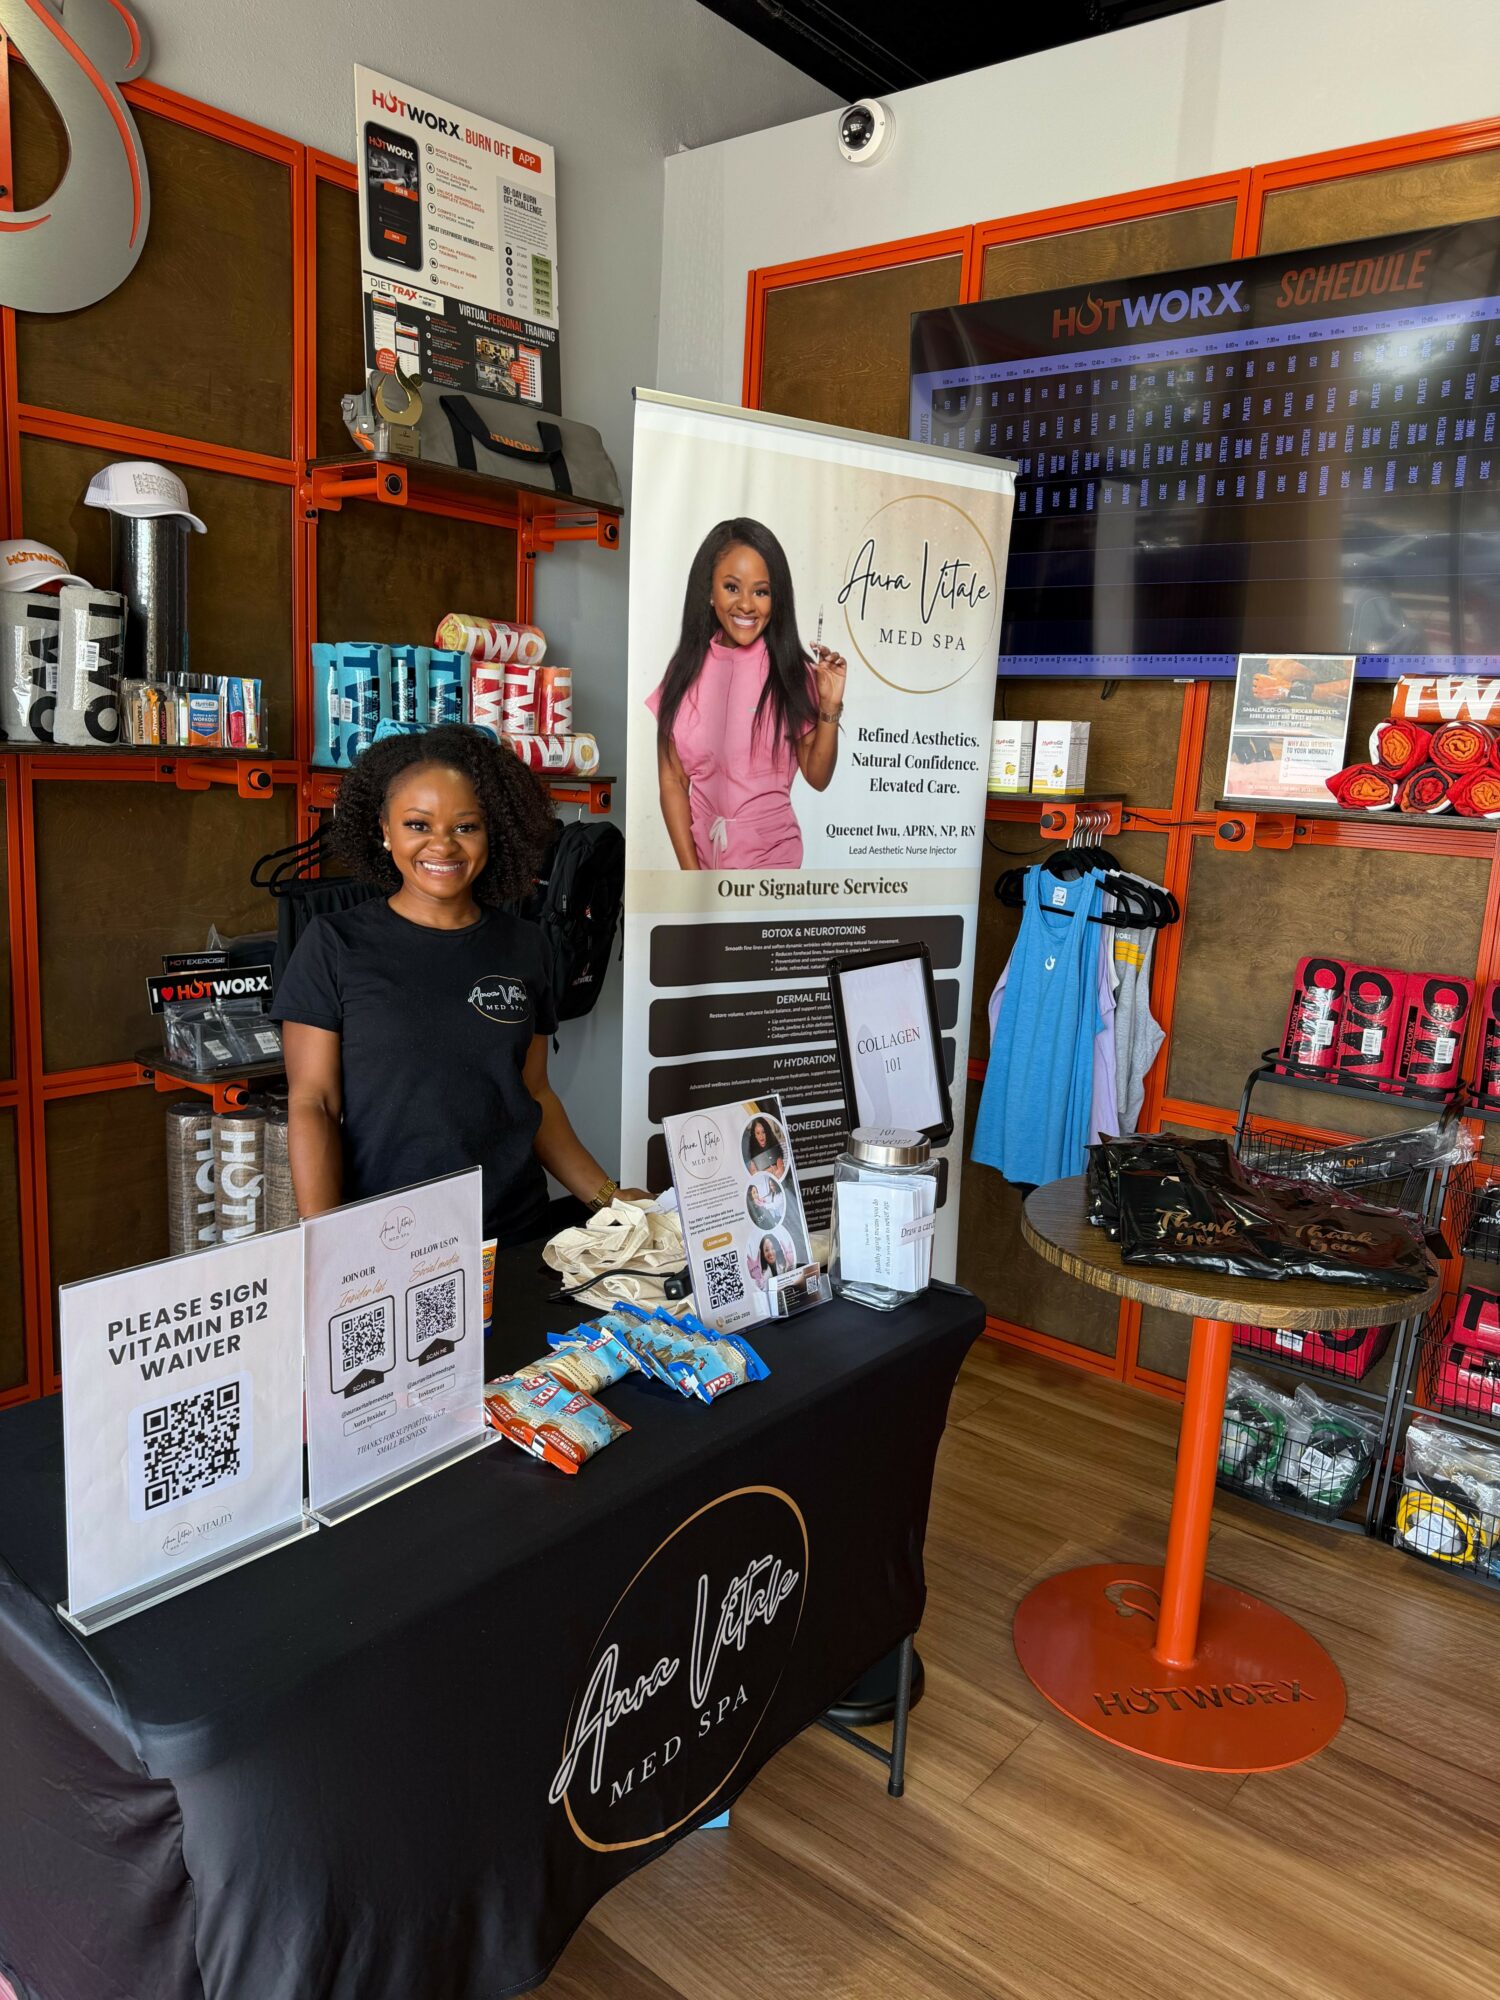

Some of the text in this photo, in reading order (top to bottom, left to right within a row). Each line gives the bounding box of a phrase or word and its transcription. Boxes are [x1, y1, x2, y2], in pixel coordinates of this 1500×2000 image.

[372, 89, 460, 140] HOTWORX
[465, 128, 491, 153] BURN
[494, 141, 510, 159] OFF
[519, 153, 535, 167] APP
[368, 136, 414, 161] HOTWORX
[503, 196, 514, 208] OFF
[514, 200, 543, 217] CHALLENGE
[522, 193, 537, 203] BURN
[1276, 249, 1432, 309] SCHEDULE
[1052, 281, 1243, 338] HOTWORX
[459, 303, 555, 342] VIRTUAL PERSONAL TRAINING
[1470, 334, 1480, 352] BUNS
[1464, 372, 1476, 400] PILATES
[1326, 387, 1336, 412] PILATES
[1436, 416, 1447, 446] STRETCH
[1455, 418, 1465, 440] BARRE
[1466, 418, 1476, 438] NONE
[1485, 412, 1496, 442] STRETCH
[1106, 446, 1115, 472] STRETCH
[1480, 460, 1490, 479] CORE
[1319, 465, 1329, 496] WARRIOR
[1362, 466, 1373, 489] BANDS
[1455, 455, 1467, 487] WARRIOR
[1019, 491, 1027, 512] BANDS
[837, 538, 990, 624] Aura Vitale
[464, 626, 546, 666] TWO
[879, 629, 966, 651] MED SPA
[1401, 679, 1500, 720] TW
[858, 727, 980, 747] Refined Aesthetics.
[514, 736, 598, 769] TWO
[851, 752, 980, 771] Natural Confidence.
[869, 778, 960, 794] Elevated Care.
[826, 824, 976, 839] Queenet Iwu, APRN, NP, RN
[849, 845, 957, 857] Lead Aesthetic Nurse Injector
[718, 877, 908, 900] Our Signature Services
[762, 925, 866, 938] BOTOX & NEUROTOXINS
[153, 976, 269, 1003] I HOTWORX
[777, 993, 831, 1005] DERMAL FILL
[857, 1027, 921, 1055] COLLAGEN
[774, 1054, 836, 1069] IV HYDRATION
[885, 1057, 902, 1074] 101
[787, 1117, 842, 1132] RONEEDLING
[900, 1224, 916, 1238] Draw
[1156, 1208, 1241, 1239] Thank
[410, 1236, 458, 1259] FOLLOW US ON
[1173, 1231, 1222, 1246] you
[342, 1266, 375, 1284] JOIN OUR
[107, 1278, 269, 1342] PLEASE SIGN
[109, 1302, 269, 1365] VITAMIN B12
[140, 1335, 241, 1381] WAIVER
[426, 1347, 448, 1362] SCAN ME
[353, 1383, 367, 1392] SCAN
[357, 1416, 431, 1455] THANKS FOR SUPPORTING
[541, 1430, 578, 1459] PEANUT BUTTER
[377, 1442, 397, 1456] SMALL
[196, 1513, 233, 1533] VITALITY
[548, 1554, 799, 1805] Aura Vitale
[1092, 1679, 1318, 1716] HOTWORX
[609, 1684, 748, 1808] MED SPA
